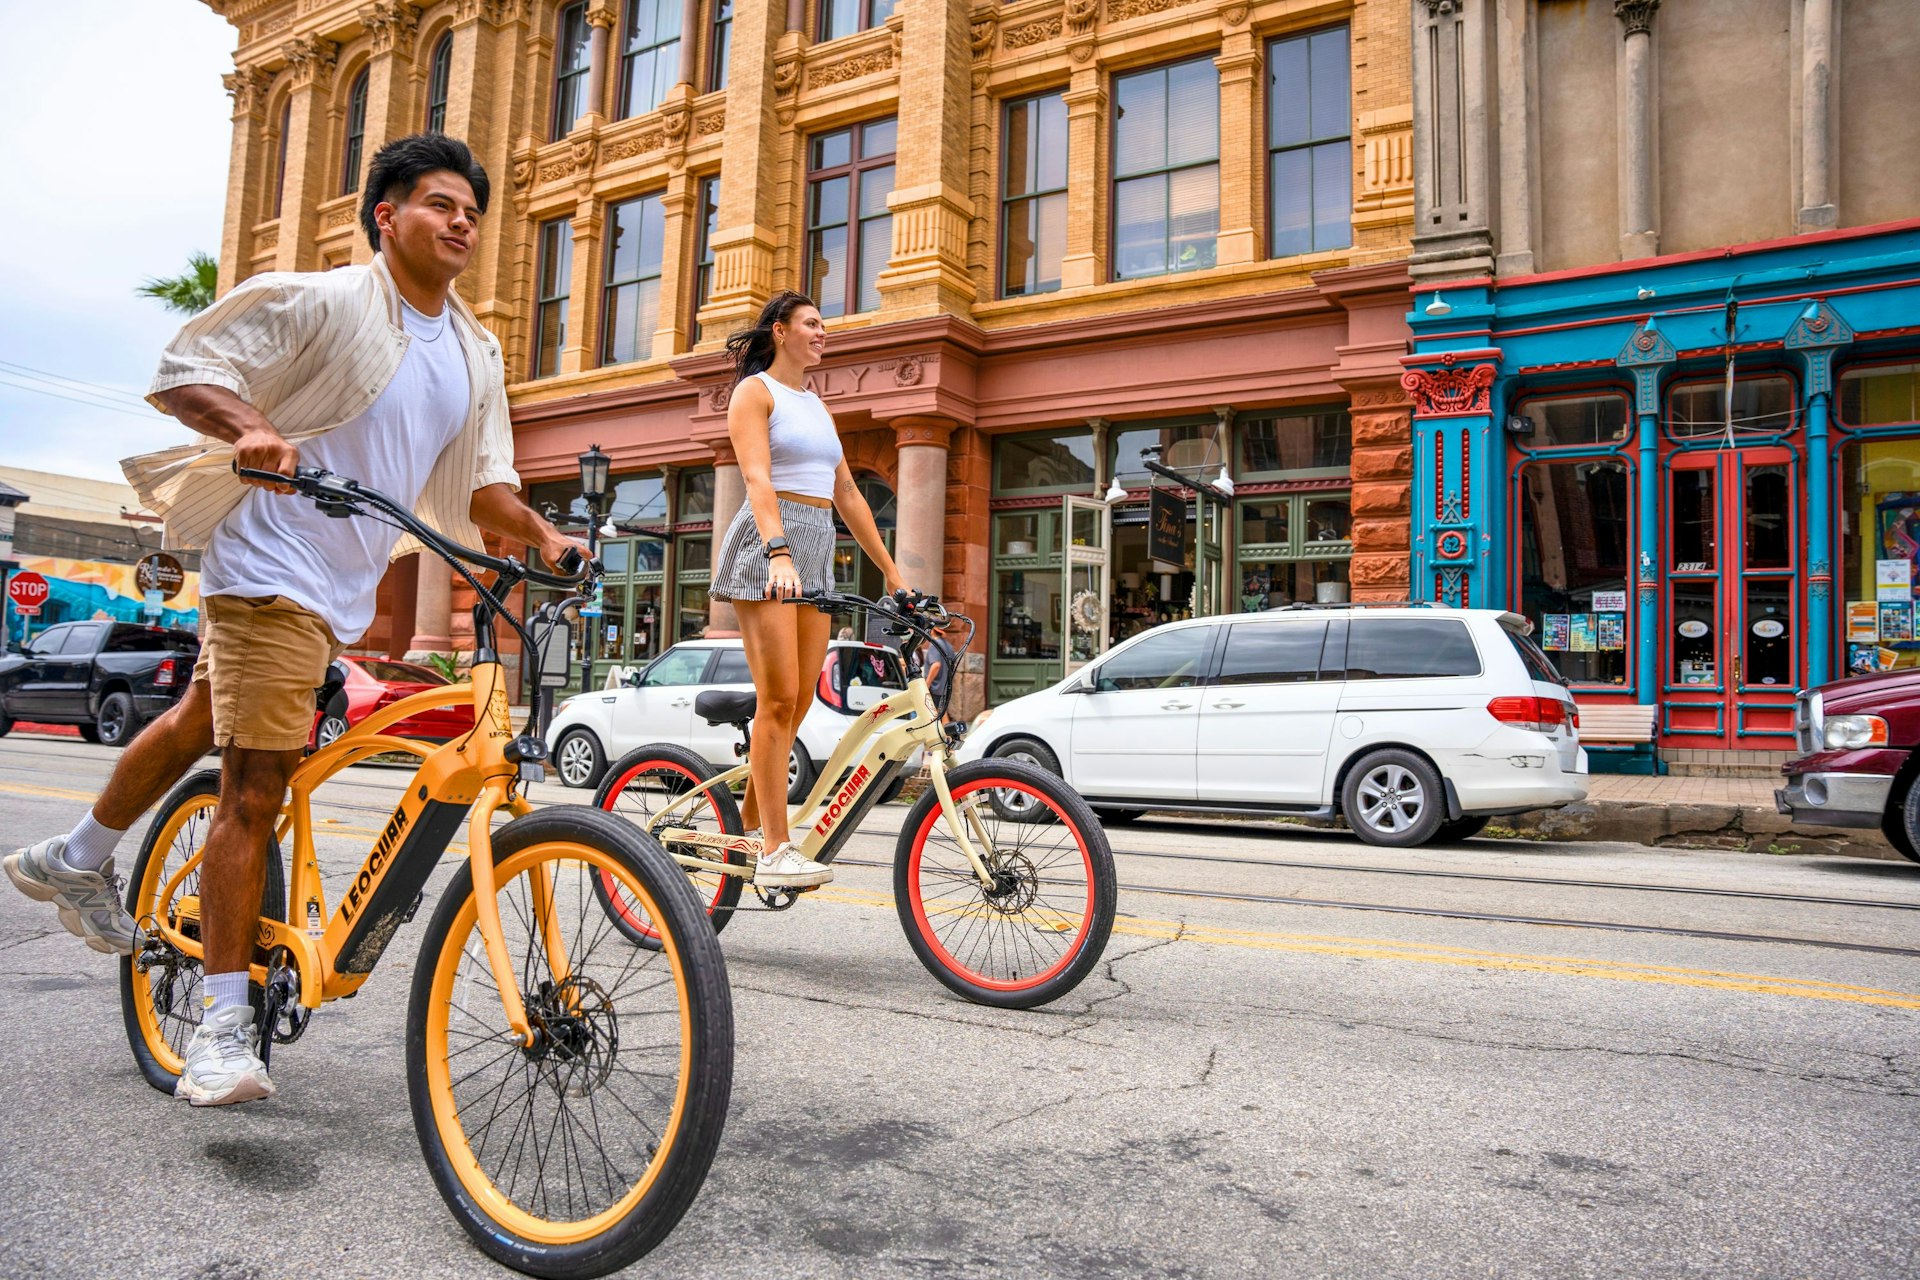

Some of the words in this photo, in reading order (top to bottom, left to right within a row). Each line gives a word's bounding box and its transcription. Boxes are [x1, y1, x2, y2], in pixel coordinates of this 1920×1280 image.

[1443, 536, 1460, 553] 62
[1678, 563, 1705, 571] 2314
[10, 581, 47, 597] STOP
[815, 764, 871, 838] LEOGUAR
[340, 805, 409, 926] LEOGUAR
